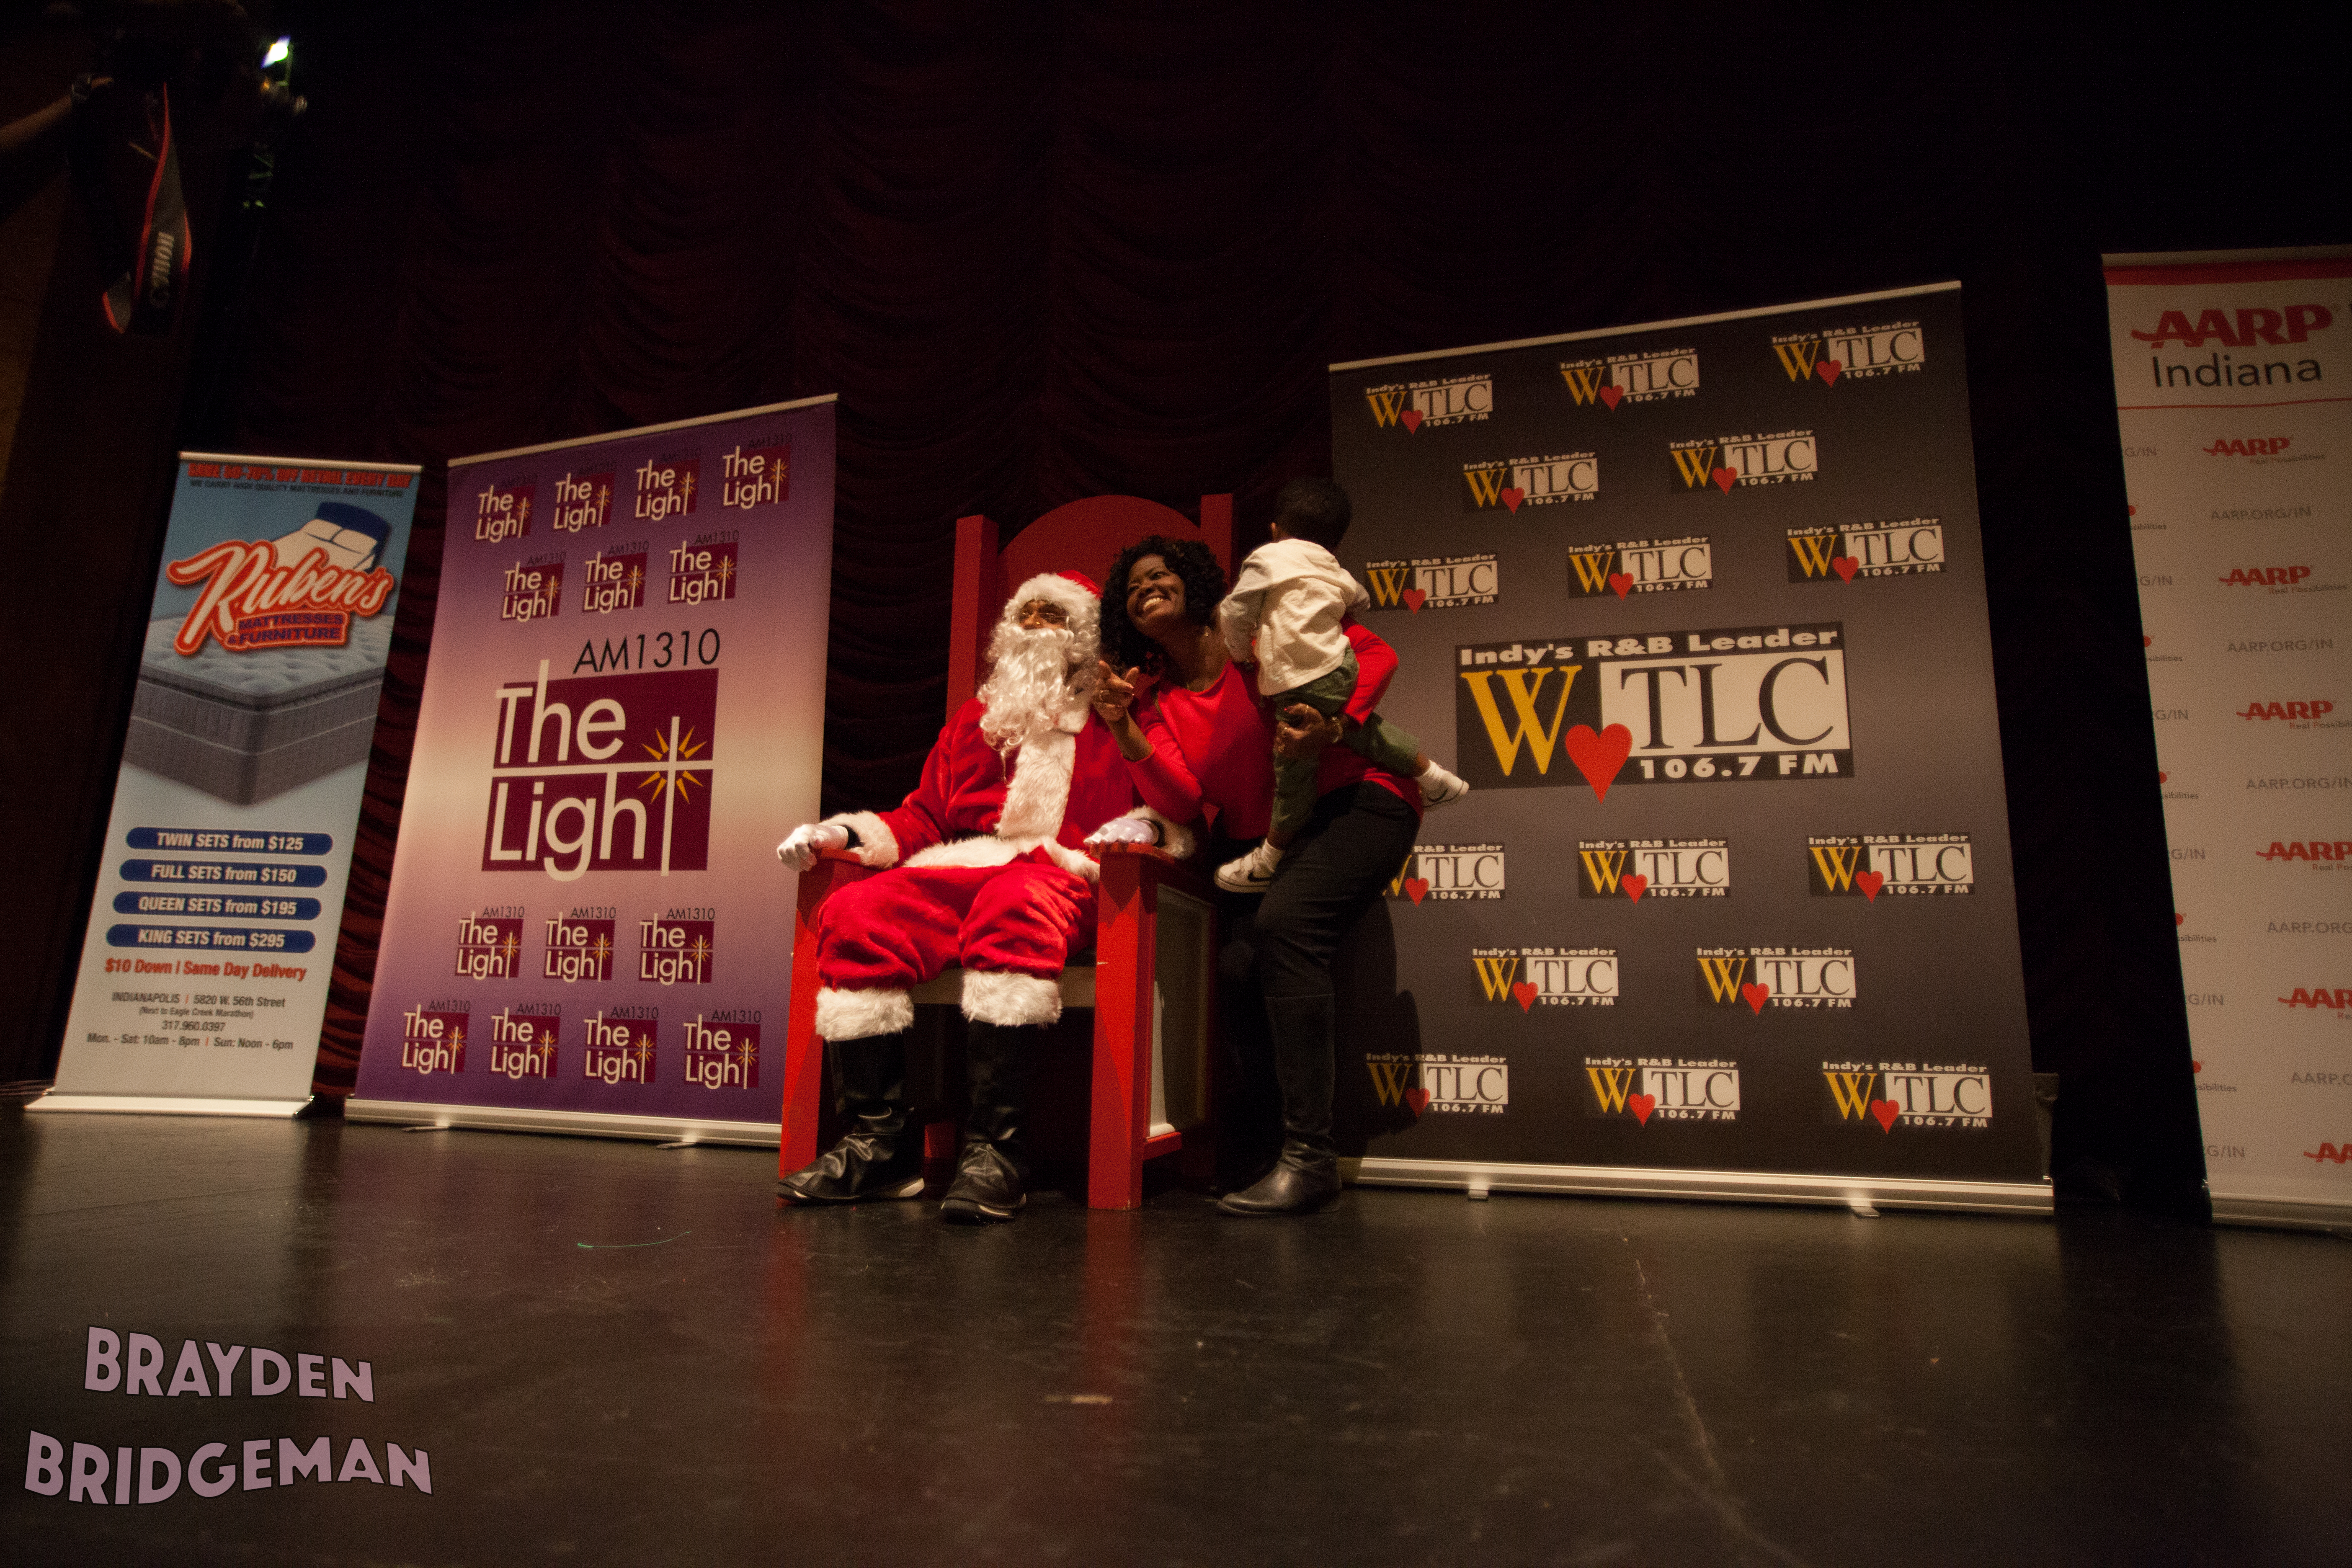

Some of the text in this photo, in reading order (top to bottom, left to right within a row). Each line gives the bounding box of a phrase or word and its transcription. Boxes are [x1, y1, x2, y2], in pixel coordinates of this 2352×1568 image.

[2131, 304, 2333, 349] AARP
[2152, 353, 2322, 387] Indiana
[2202, 437, 2290, 456] AARP
[722, 445, 766, 478] The
[636, 459, 676, 491] The
[555, 472, 592, 503] The
[478, 485, 514, 514] The
[1787, 518, 1939, 536] Indy's R&B Leader
[585, 551, 624, 583] The
[670, 541, 712, 573] The
[505, 561, 542, 592] The
[1862, 564, 1940, 577] 106.7 FM
[2220, 566, 2311, 586] AARP
[239, 613, 343, 629] MATTRESSES
[240, 628, 340, 645] FURNITURE
[1461, 628, 1838, 665] Indy's R&B Leader
[573, 627, 721, 674] AM1310
[495, 659, 627, 764] The
[2236, 700, 2333, 720] AARP
[1640, 753, 1839, 779] 106.7 FM
[490, 716, 683, 882] Light
[157, 833, 304, 851] TWIN SETS from $125
[1809, 836, 1858, 846] Indy's
[1906, 833, 1968, 843] Leader
[2256, 842, 2352, 861] AARP
[151, 864, 297, 882] FULL SETS from $150
[1887, 885, 1969, 894] 106.7 FM
[138, 896, 297, 915] QUEEN SETS from $195
[482, 906, 525, 919] AM1310
[570, 906, 616, 919] AM1310
[666, 907, 715, 921] AM1310
[459, 911, 498, 944] The
[546, 912, 588, 946] The
[640, 913, 686, 947] The
[138, 929, 285, 948] KING SETS from $295
[1697, 948, 1745, 957] Indy's
[1792, 948, 1852, 956] Leader
[106, 958, 307, 981] $10 Down Same Day Delivery
[112, 992, 181, 1003] INDIANAPOLIS
[193, 994, 217, 1005] 5820
[233, 996, 254, 1006] 56th
[257, 997, 285, 1007] Street
[1772, 998, 1852, 1007] 106.7 FM
[170, 1007, 189, 1016] Eagle
[404, 1004, 444, 1038] The
[491, 1007, 534, 1042] The
[583, 1011, 630, 1047] The
[683, 1014, 732, 1050] The
[144, 1035, 169, 1044] 10am
[238, 1038, 262, 1048] Noon
[273, 1039, 293, 1050] 6pm
[1823, 1062, 1987, 1073] Indy's R&B Leader
[1903, 1116, 1988, 1127] 106.7 FM
